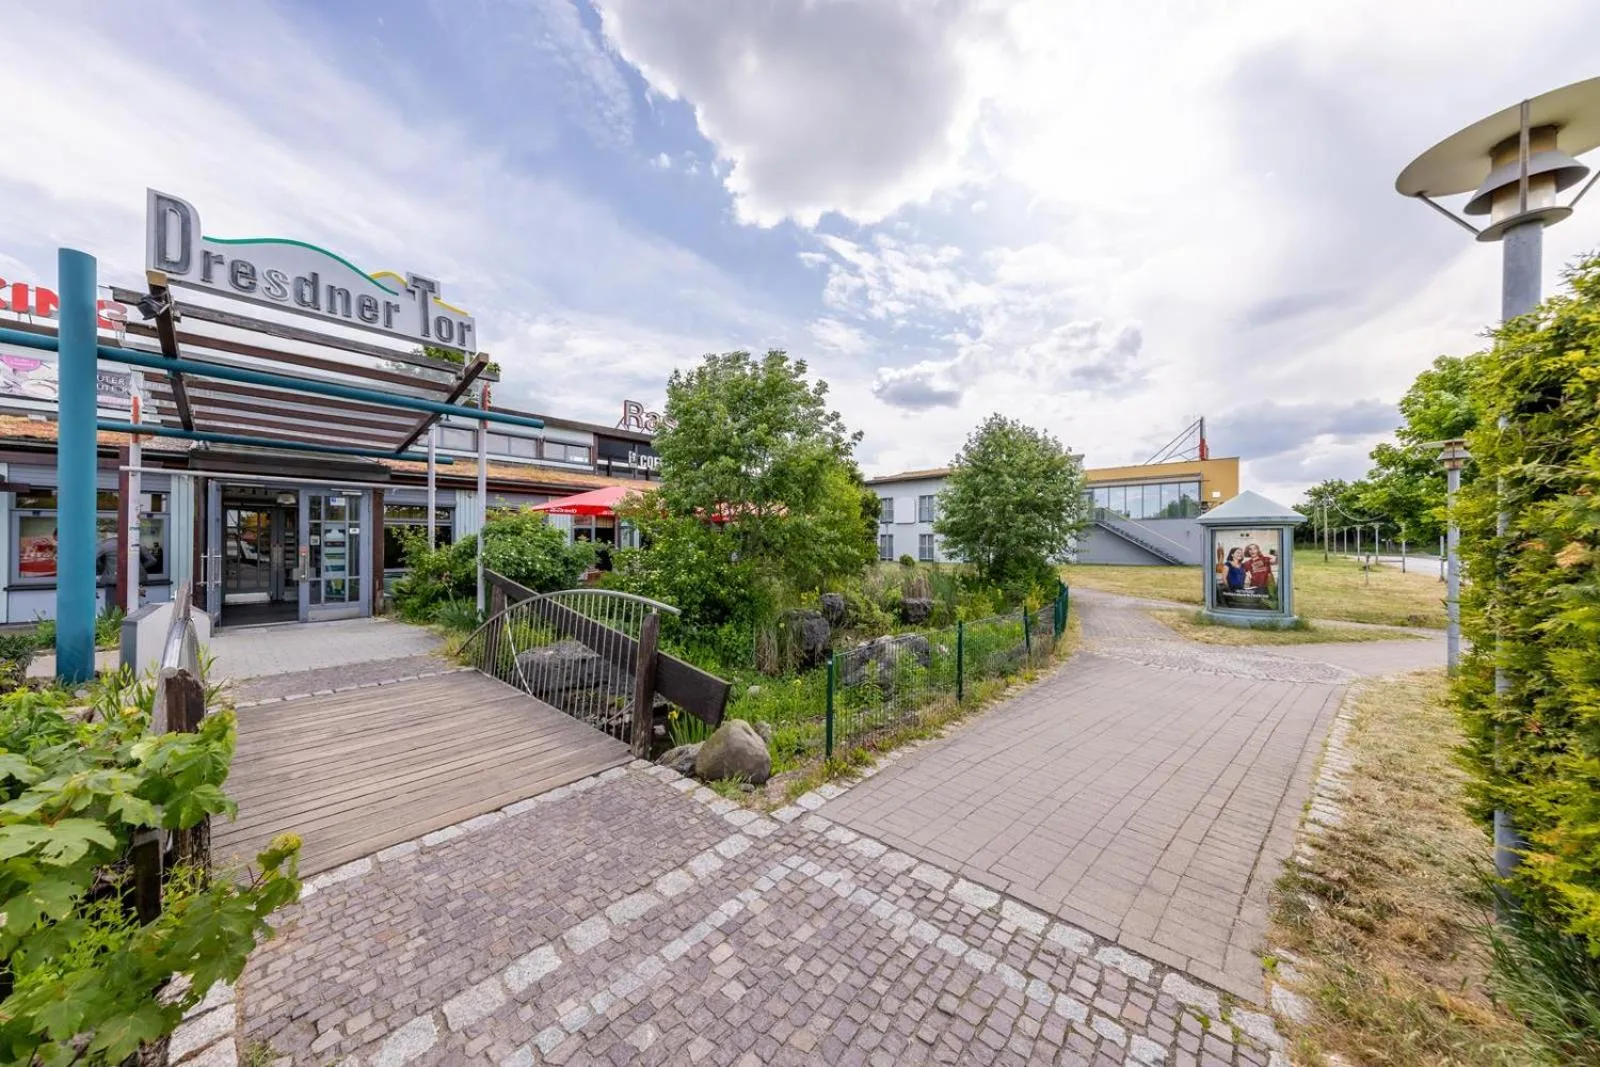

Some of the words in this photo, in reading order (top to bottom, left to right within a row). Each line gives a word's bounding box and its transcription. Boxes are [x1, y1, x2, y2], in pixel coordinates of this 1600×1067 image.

[0, 277, 128, 331] ING
[155, 193, 400, 329] Dresdner
[406, 275, 473, 347] Tor
